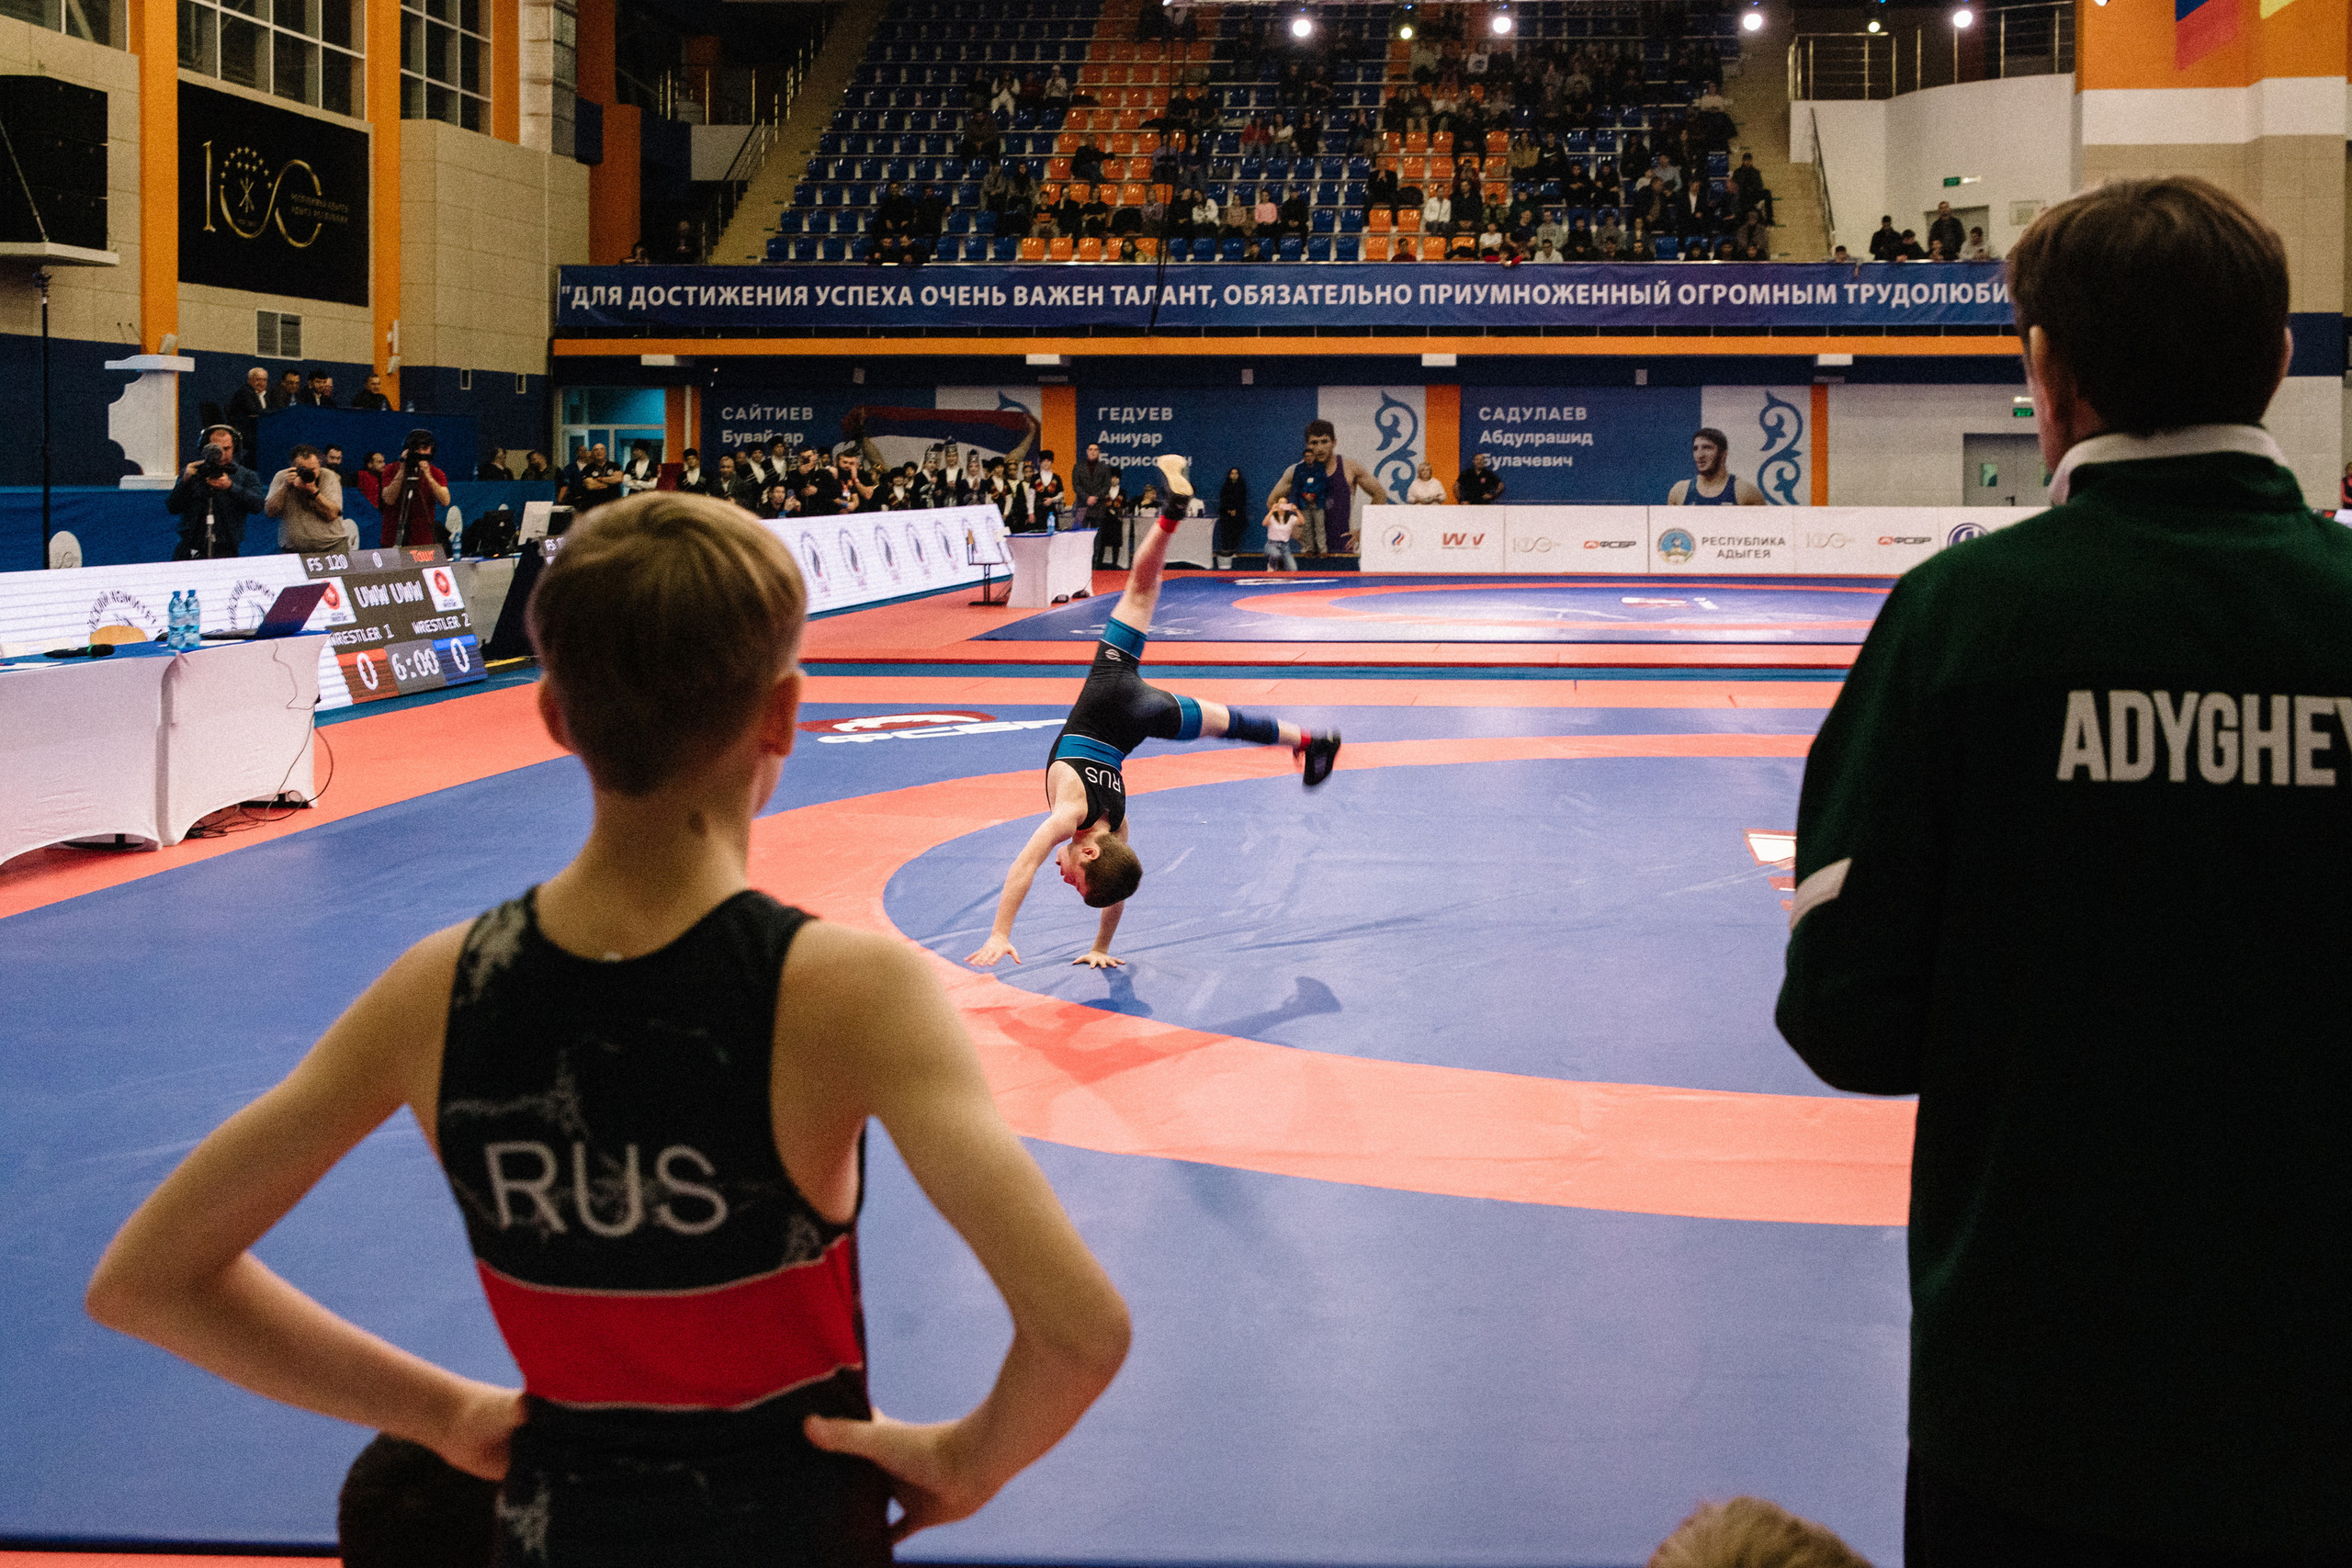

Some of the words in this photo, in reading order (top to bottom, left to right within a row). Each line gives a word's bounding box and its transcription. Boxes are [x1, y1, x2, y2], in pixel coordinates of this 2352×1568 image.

[561, 286, 623, 310] "ДЛЯ
[628, 286, 808, 310] ДОСТИЖЕНИЯ
[815, 286, 914, 306] УСПЕХА
[920, 286, 1007, 306] ОЧЕНЬ
[1013, 286, 1103, 306] ВАЖЕН
[1110, 285, 1217, 309] ТАЛАНТ,
[1223, 284, 1413, 306] ОБЯЗАТЕЛЬНО
[1419, 280, 1671, 305] ПРИУМНОЖЕННЫЙ
[1677, 283, 1838, 305] ОГРОМНЫМ
[721, 404, 813, 421] САЙТИЕВ
[1098, 407, 1173, 423] ГЕДУЕВ
[1478, 406, 1588, 423] САДУЛАЕВ
[1097, 430, 1162, 447] Аниуар
[1479, 429, 1594, 448] Абдулрашид
[1702, 536, 1786, 546] РЕСПУБЛИКА
[306, 557, 323, 572] FS
[325, 554, 348, 571] 120
[372, 551, 383, 569] 0
[410, 549, 435, 563] Tour
[1716, 549, 1771, 559] АДЫГЕЯ
[383, 624, 395, 639] 1
[412, 615, 461, 635] WRESTLER
[461, 613, 471, 627] 2
[450, 637, 470, 673] 0
[356, 652, 379, 690] 0
[391, 648, 440, 681] 6:00
[1084, 766, 1122, 794] RUS
[483, 1140, 729, 1237] RUS
